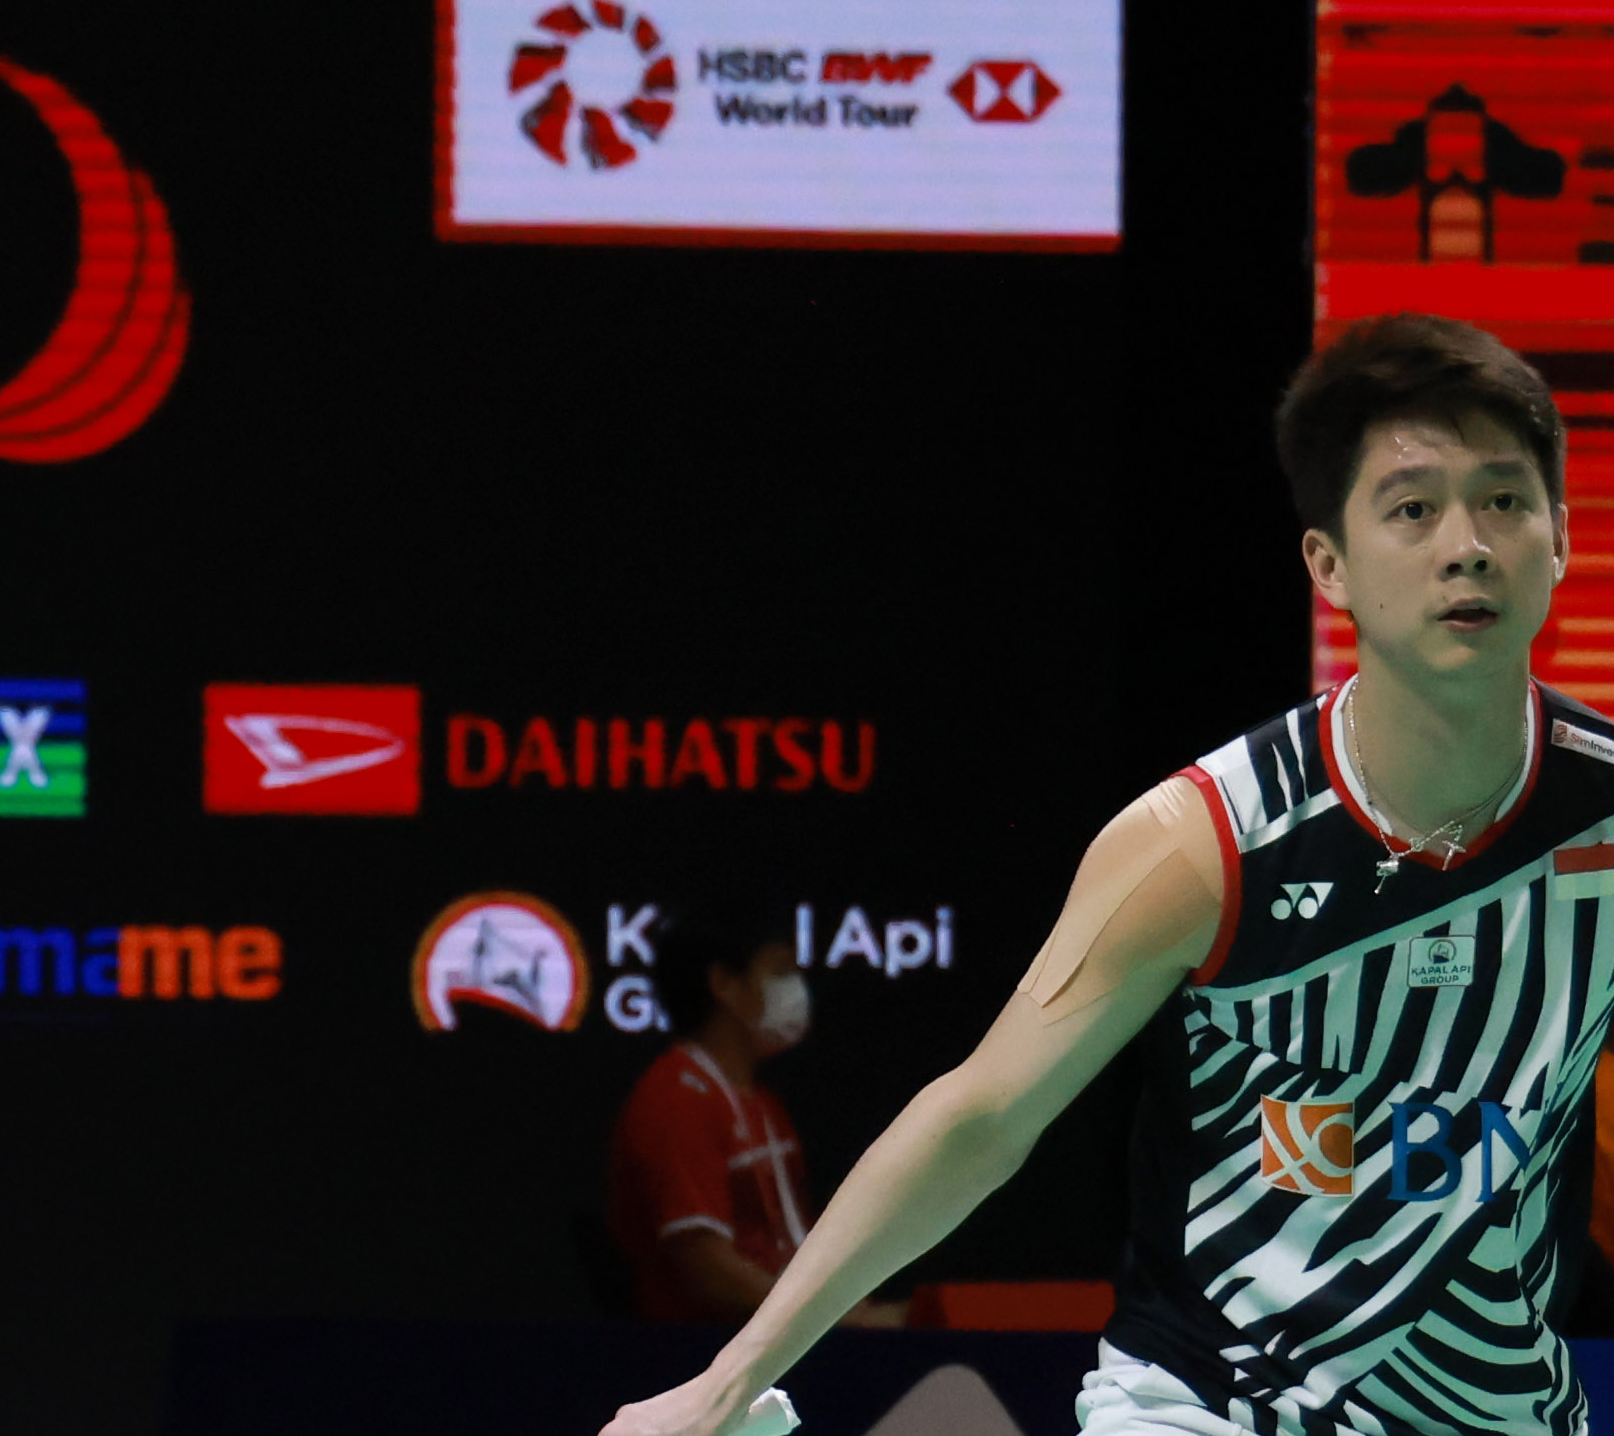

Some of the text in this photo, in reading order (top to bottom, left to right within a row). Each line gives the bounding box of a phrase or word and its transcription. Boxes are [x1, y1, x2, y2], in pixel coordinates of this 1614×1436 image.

[698, 49, 808, 84] HSBC
[714, 95, 919, 127] World Tour
[445, 714, 877, 793] DAIHATSU
[826, 903, 954, 979] Api
[1411, 965, 1472, 976] KAPAL API
[1421, 975, 1459, 985] GROUP
